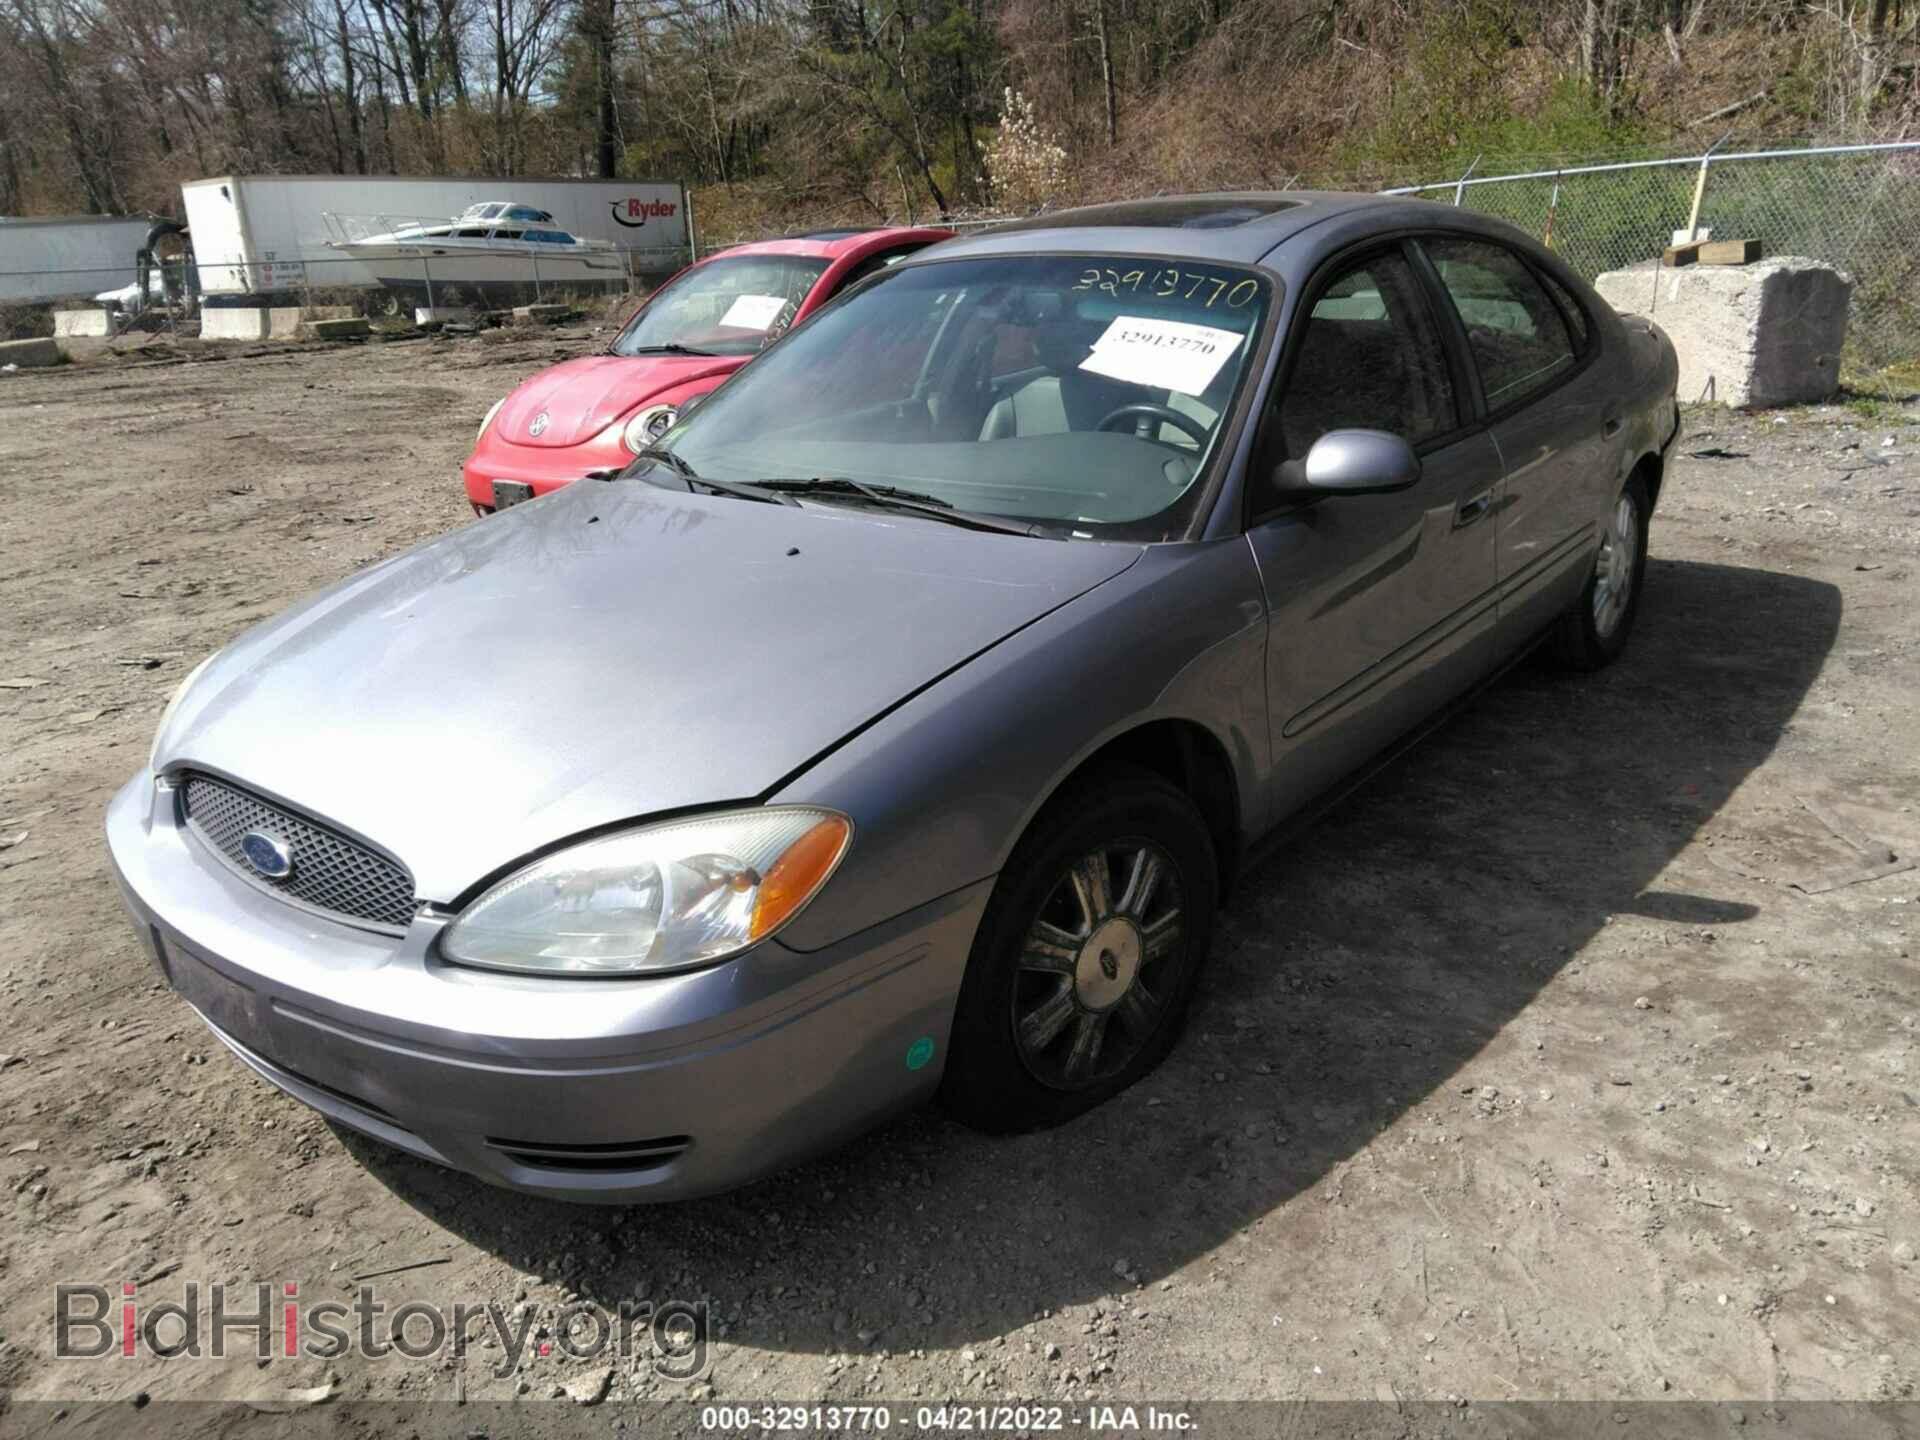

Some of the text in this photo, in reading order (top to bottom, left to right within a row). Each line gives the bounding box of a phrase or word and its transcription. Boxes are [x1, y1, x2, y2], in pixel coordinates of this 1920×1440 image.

[628, 198, 677, 222] Ryder
[1072, 269, 1258, 307] 32913770
[1113, 331, 1216, 354] 32913770
